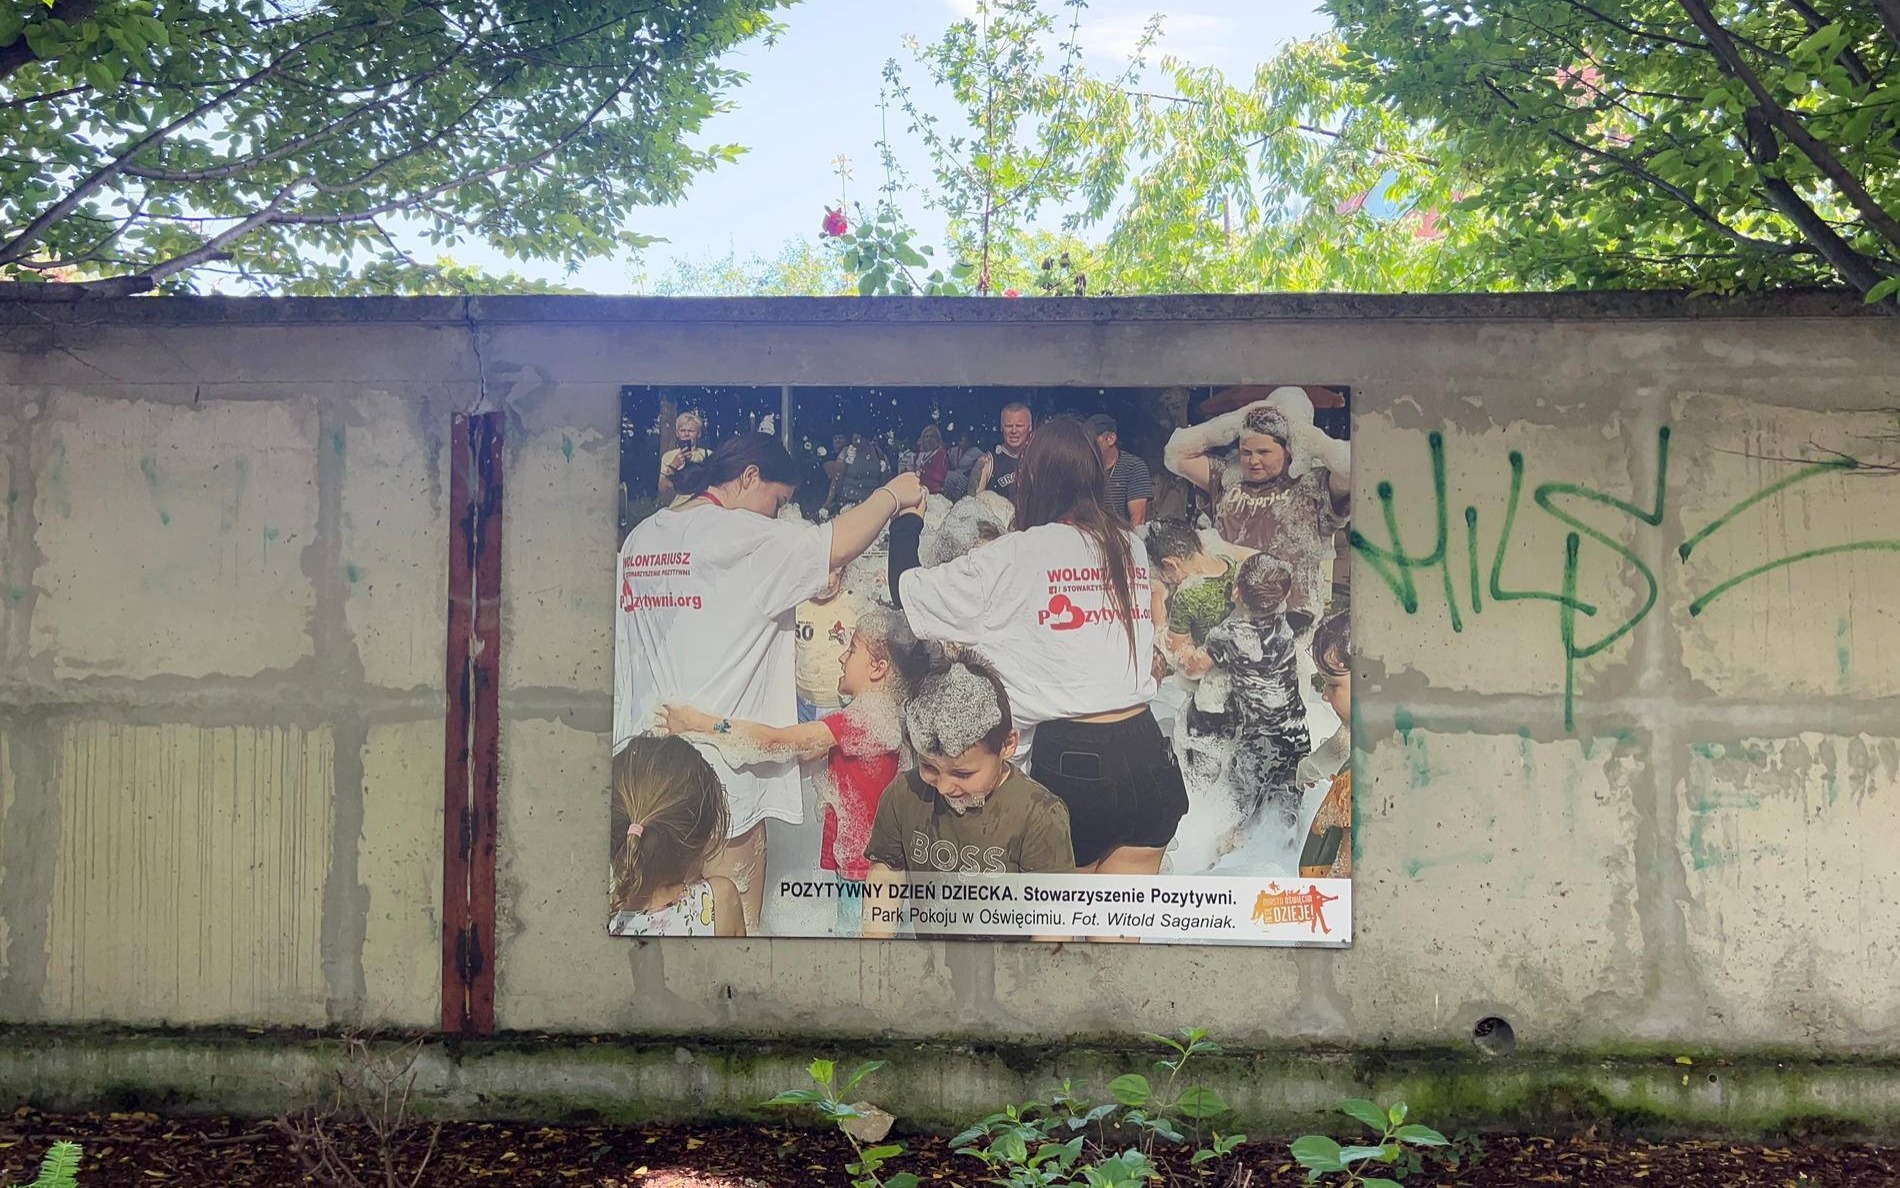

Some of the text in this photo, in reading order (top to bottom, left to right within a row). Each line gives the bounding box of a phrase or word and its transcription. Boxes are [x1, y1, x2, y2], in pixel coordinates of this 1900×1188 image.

[910, 830, 1007, 878] BOSS
[781, 880, 1237, 908] POZYTYWNY DZIEŃ DZIECKA. Stowarzyszenie Pozytywni.
[872, 906, 1236, 931] Park Pokoju w Oświęcimiu. Fot. Witold Saganiak.
[1274, 904, 1315, 922] DZIEJE!
